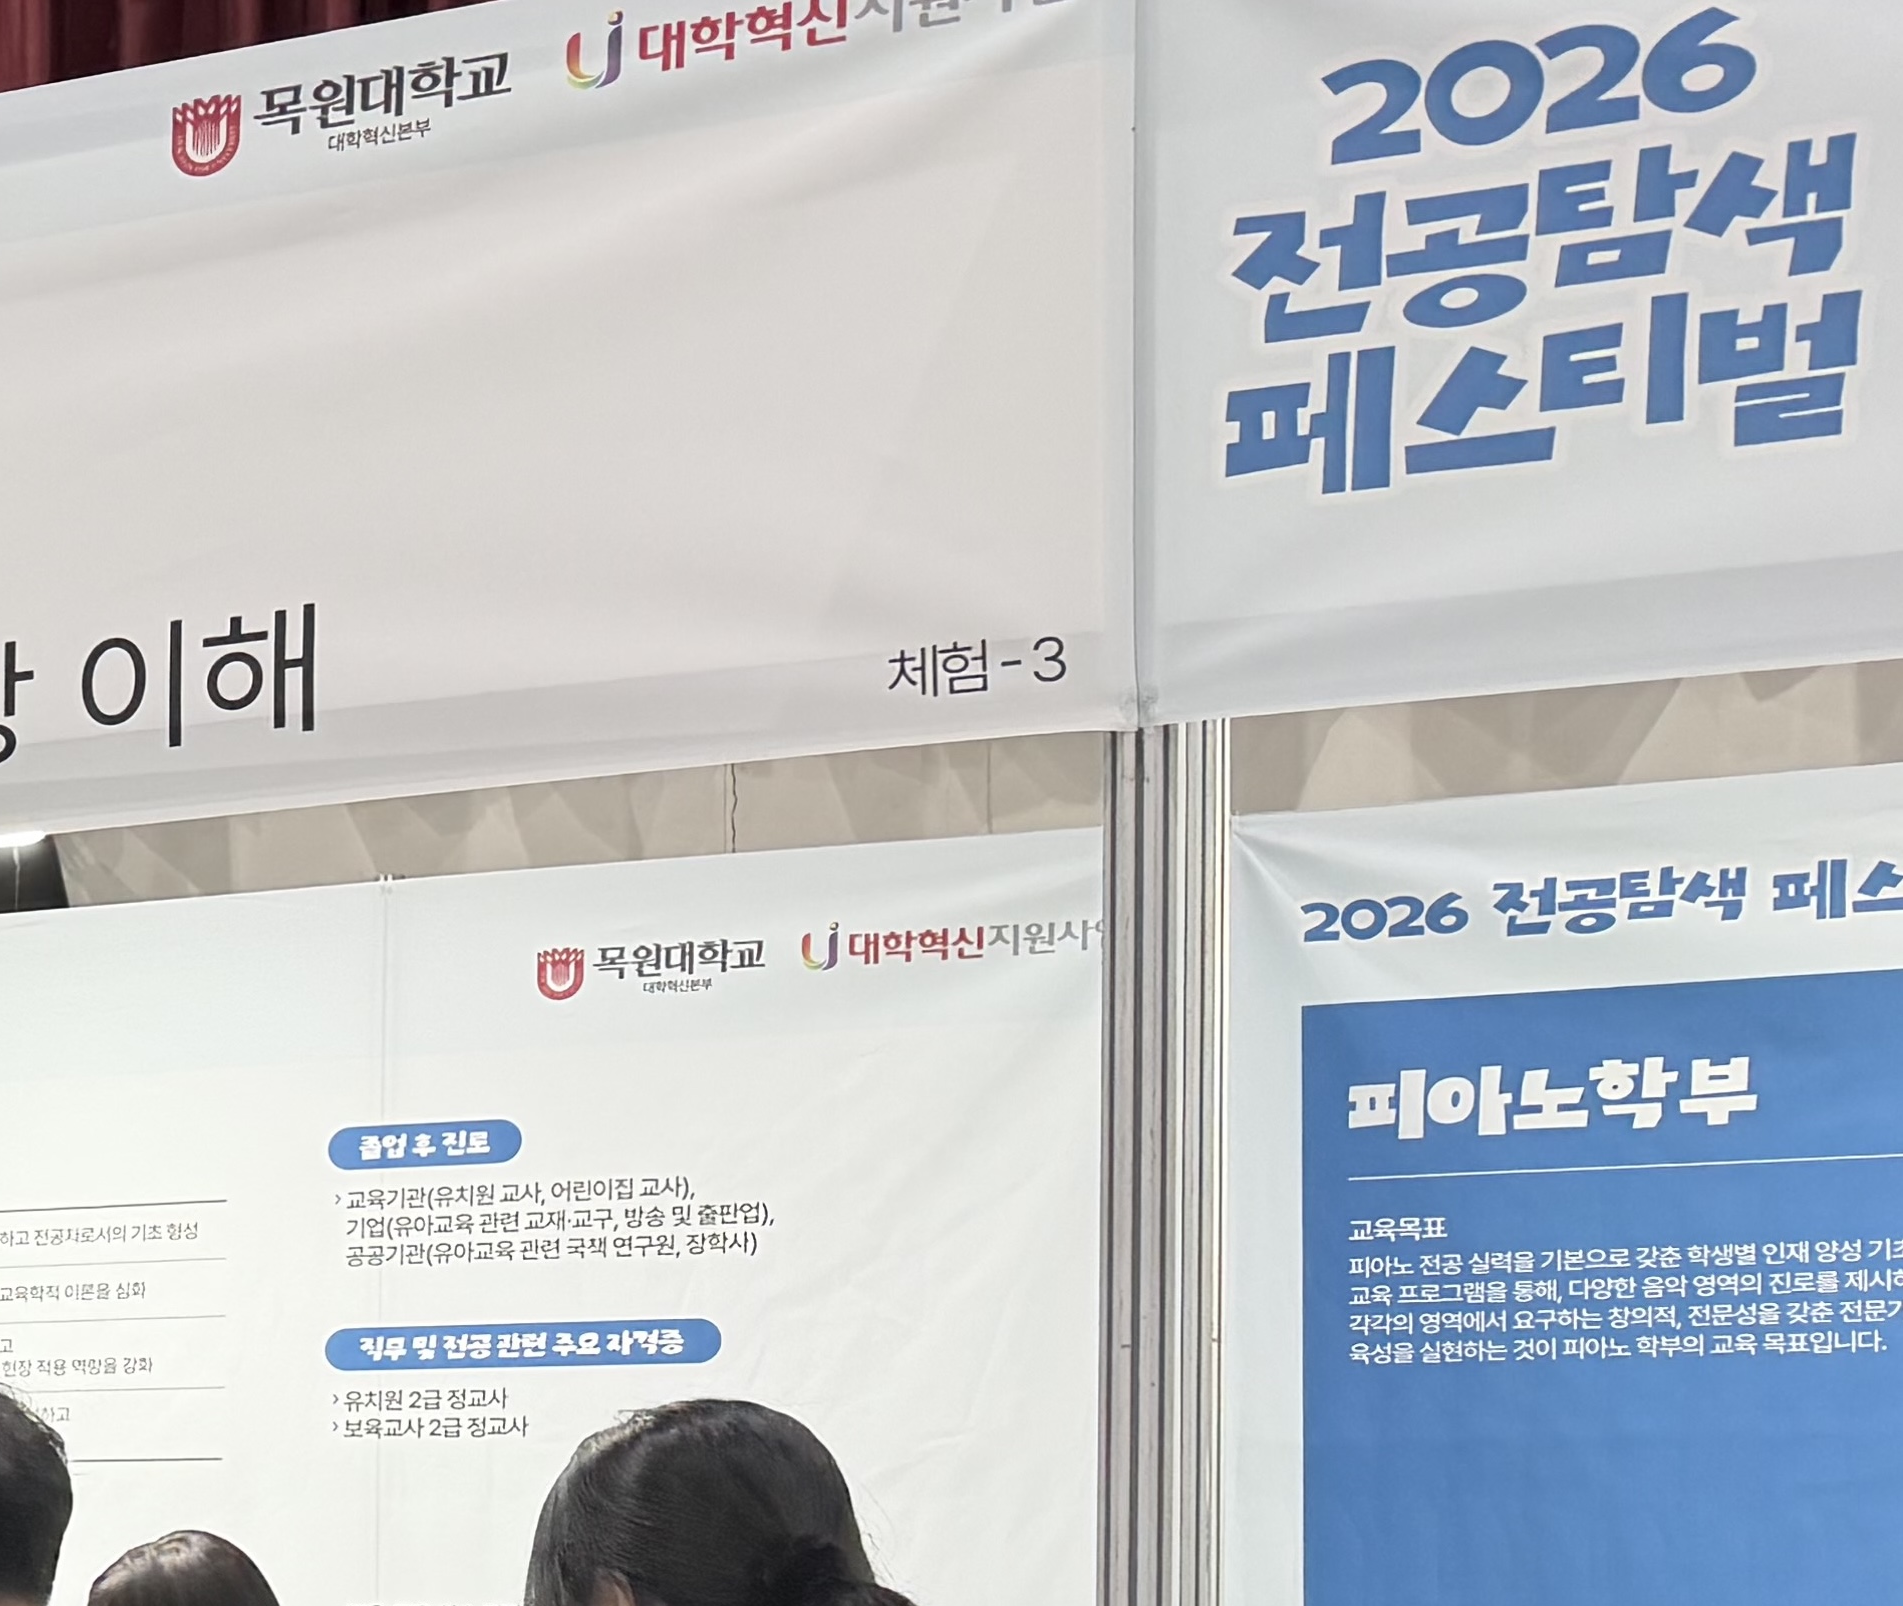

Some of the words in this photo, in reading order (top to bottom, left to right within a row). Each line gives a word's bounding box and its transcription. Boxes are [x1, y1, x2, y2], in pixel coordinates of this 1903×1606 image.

[253, 50, 512, 137] 목원대학교
[1322, 7, 1756, 165] 2026
[328, 118, 432, 153] 대학혁신본부
[1231, 131, 1857, 343] 전공탐색
[1224, 289, 1863, 495] 페스티벌
[81, 602, 318, 748] 이해
[1301, 892, 1469, 942] 2026
[1493, 866, 1748, 937] 전공탐색
[594, 939, 766, 980] 목원대학교
[643, 976, 713, 994] 대학혁신본부
[1348, 1056, 1757, 1140] 피아노학부
[359, 1133, 407, 1161] 졸업
[412, 1132, 436, 1157] 후
[442, 1129, 490, 1156] 진로
[347, 1184, 495, 1212] 교육기관(유치원
[500, 1183, 546, 1206] 교사,
[551, 1178, 634, 1203] 어린이집
[639, 1175, 696, 1201] 교사),
[34, 1225, 126, 1246] 전공자로서의
[131, 1224, 163, 1241] 기초
[167, 1222, 198, 1240] 형성
[347, 1212, 474, 1241] 기업(유아교육
[479, 1212, 519, 1234] 관련
[623, 1205, 665, 1229] 방송
[672, 1204, 692, 1227] 및
[1349, 1217, 1447, 1241] 교육목표
[346, 1240, 515, 1268] 공공기관(유아교육
[520, 1237, 560, 1261] 관련
[566, 1236, 606, 1259] 국책
[612, 1234, 680, 1261] 연구원,
[686, 1231, 758, 1256] 장학사)
[1349, 1256, 1414, 1278] 피아노
[1419, 1254, 1463, 1275] 전공
[1469, 1251, 1534, 1273] 실력을
[1540, 1248, 1631, 1272] 기본으로
[1636, 1246, 1681, 1268] 갖춘
[1687, 1243, 1757, 1267] 학생별
[1763, 1241, 1809, 1265] 인재
[1815, 1239, 1862, 1263] 양성
[0, 1285, 60, 1303] 교육학적
[65, 1283, 110, 1300] 이론을
[116, 1282, 145, 1299] 심화
[1349, 1285, 1392, 1306] 교육
[1397, 1281, 1507, 1304] 프로그램을
[1512, 1279, 1563, 1304] 통해,
[1568, 1275, 1637, 1301] 다양한
[1642, 1275, 1688, 1298] 음악
[1693, 1272, 1762, 1296] 영역의
[1769, 1270, 1839, 1294] 진로를
[1349, 1312, 1413, 1336] 각각의
[1419, 1310, 1507, 1334] 영역에서
[1513, 1307, 1602, 1331] 요구하는
[1607, 1305, 1681, 1330] 창의적,
[1688, 1303, 1780, 1327] 전문성을
[1787, 1301, 1833, 1324] 갖춘
[359, 1336, 405, 1361] 직무
[412, 1334, 437, 1361] 및
[443, 1334, 492, 1360] 전공
[497, 1332, 547, 1358] 관련
[552, 1332, 600, 1356] 주요
[606, 1329, 684, 1355] 자격증
[1349, 1341, 1414, 1364] 육성을
[1419, 1340, 1507, 1362] 실현하는
[1513, 1337, 1556, 1361] 것이
[1562, 1336, 1631, 1360] 피아노
[1636, 1334, 1704, 1357] 학부의
[1710, 1332, 1758, 1356] 교육
[1764, 1329, 1887, 1354] 목표입니다.
[344, 1390, 403, 1412] 유치원
[408, 1390, 441, 1410] 2급
[447, 1387, 508, 1410] 정교사
[344, 1418, 423, 1438] 보육교사
[429, 1417, 462, 1438] 2급
[468, 1415, 529, 1437] 정교사
